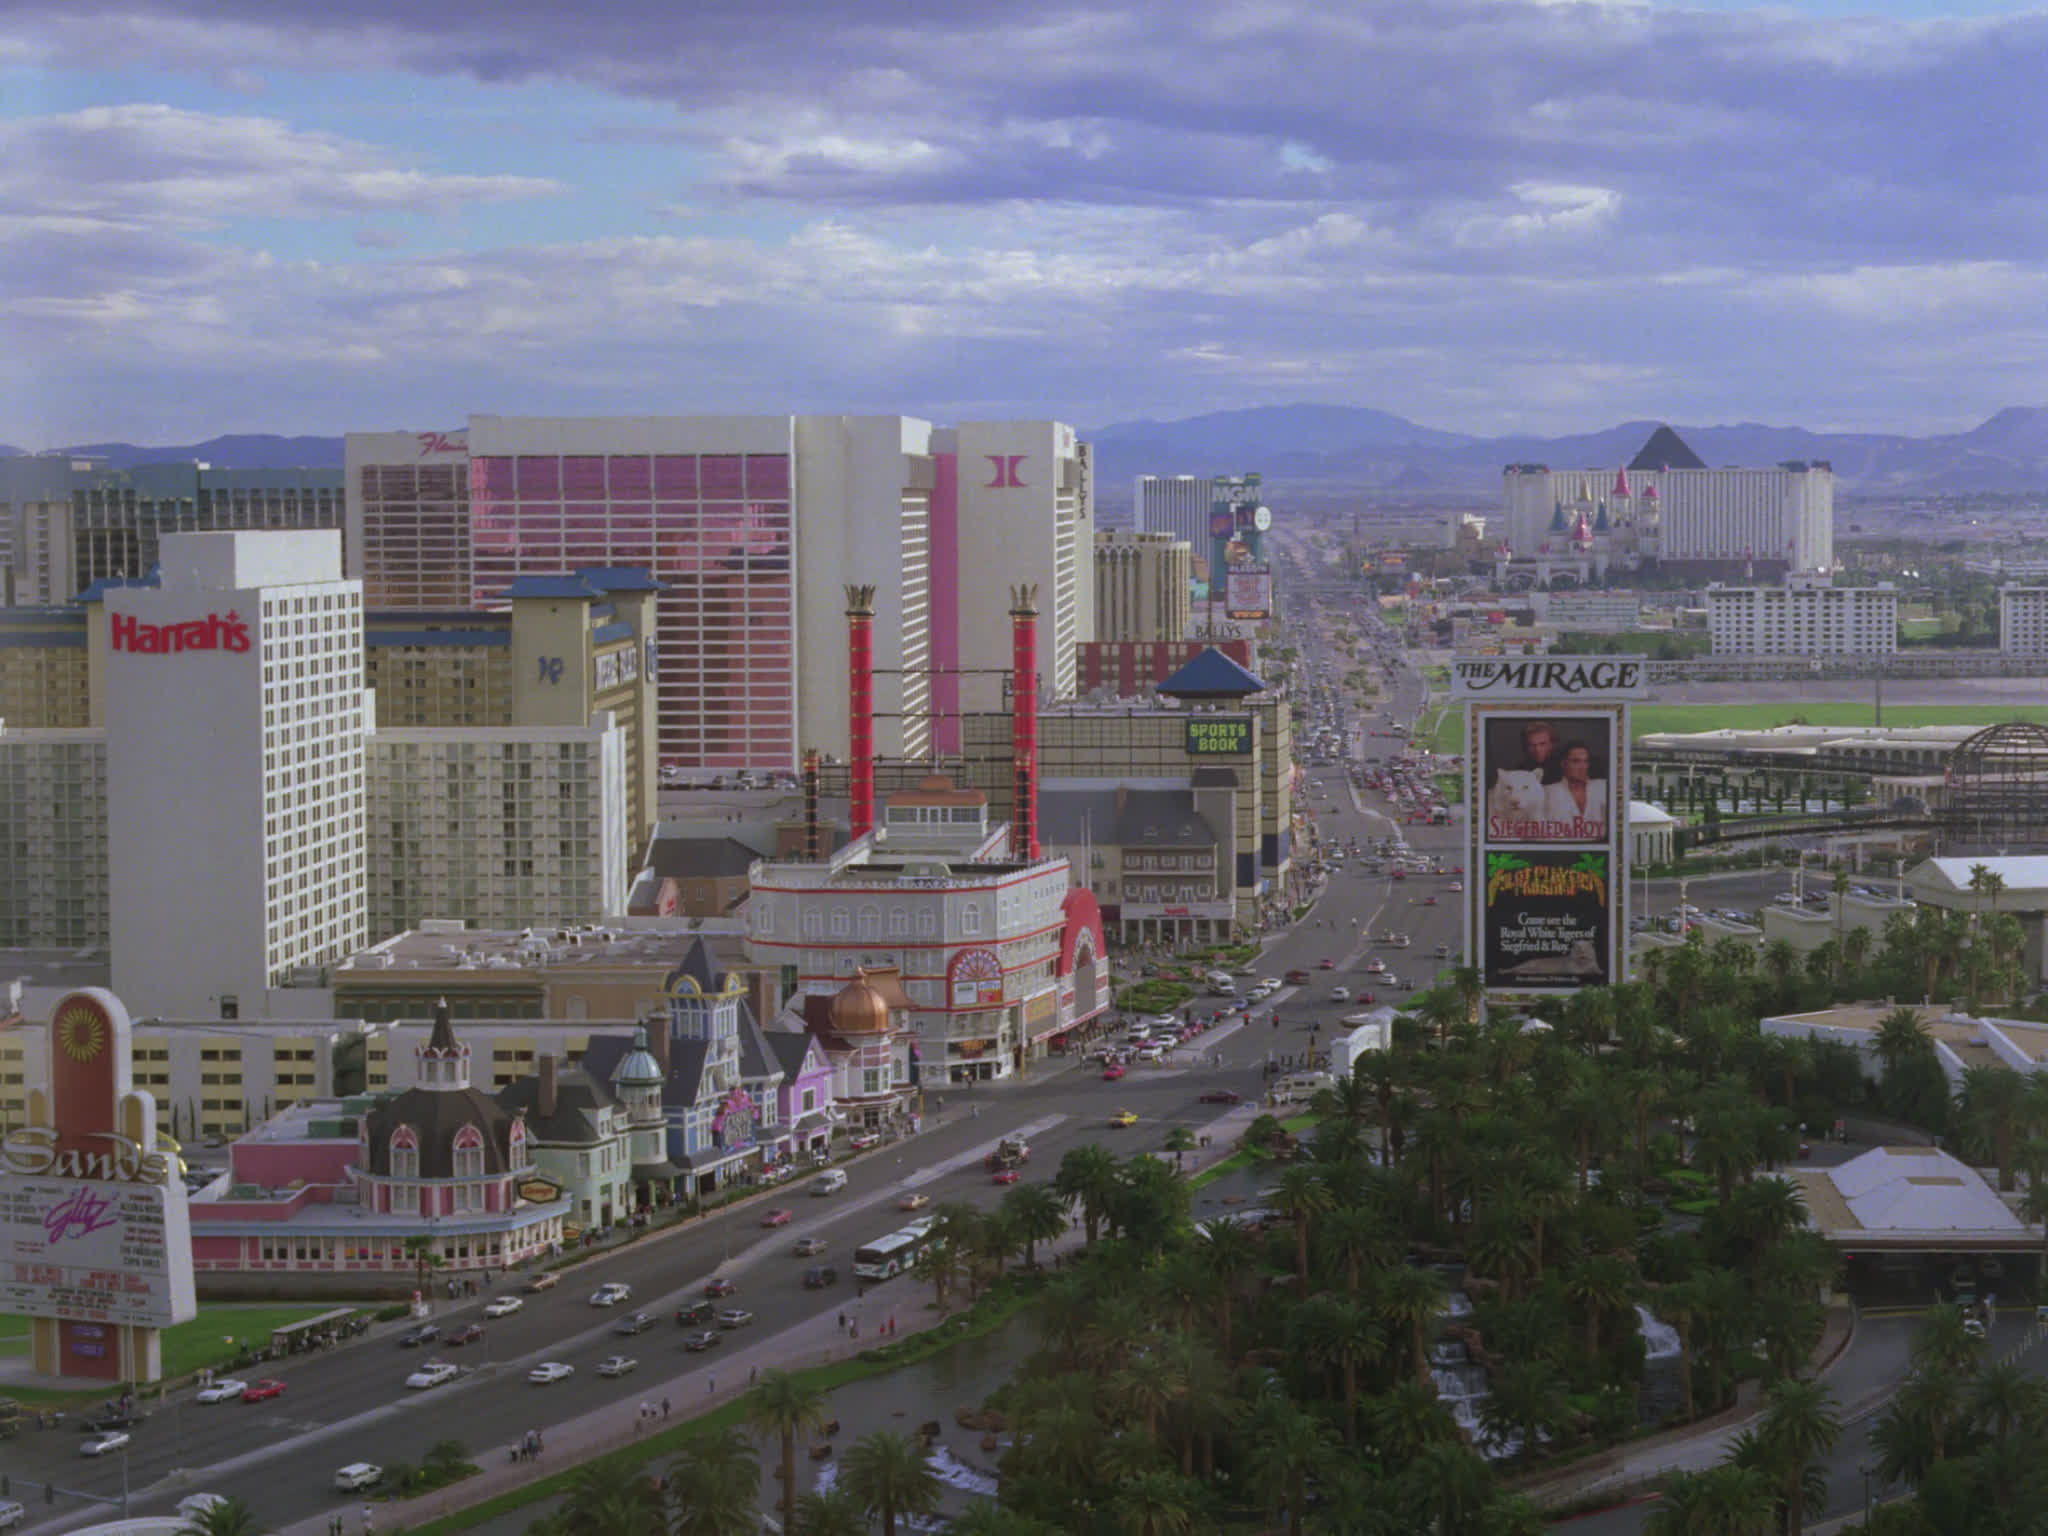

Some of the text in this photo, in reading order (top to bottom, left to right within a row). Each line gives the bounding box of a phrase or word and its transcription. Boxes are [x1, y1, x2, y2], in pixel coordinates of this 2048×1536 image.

[111, 608, 250, 654] Harrah's
[1456, 662, 1640, 693] THE MIRAGE
[1190, 724, 1247, 737] SPORTS
[1198, 738, 1239, 752] BOOK
[1518, 912, 1545, 926] Come
[1562, 912, 1577, 926] the
[1501, 926, 1527, 942] Royal
[1529, 926, 1557, 938] White
[1501, 940, 1541, 955] Siegfried
[2, 1127, 168, 1184] Sands
